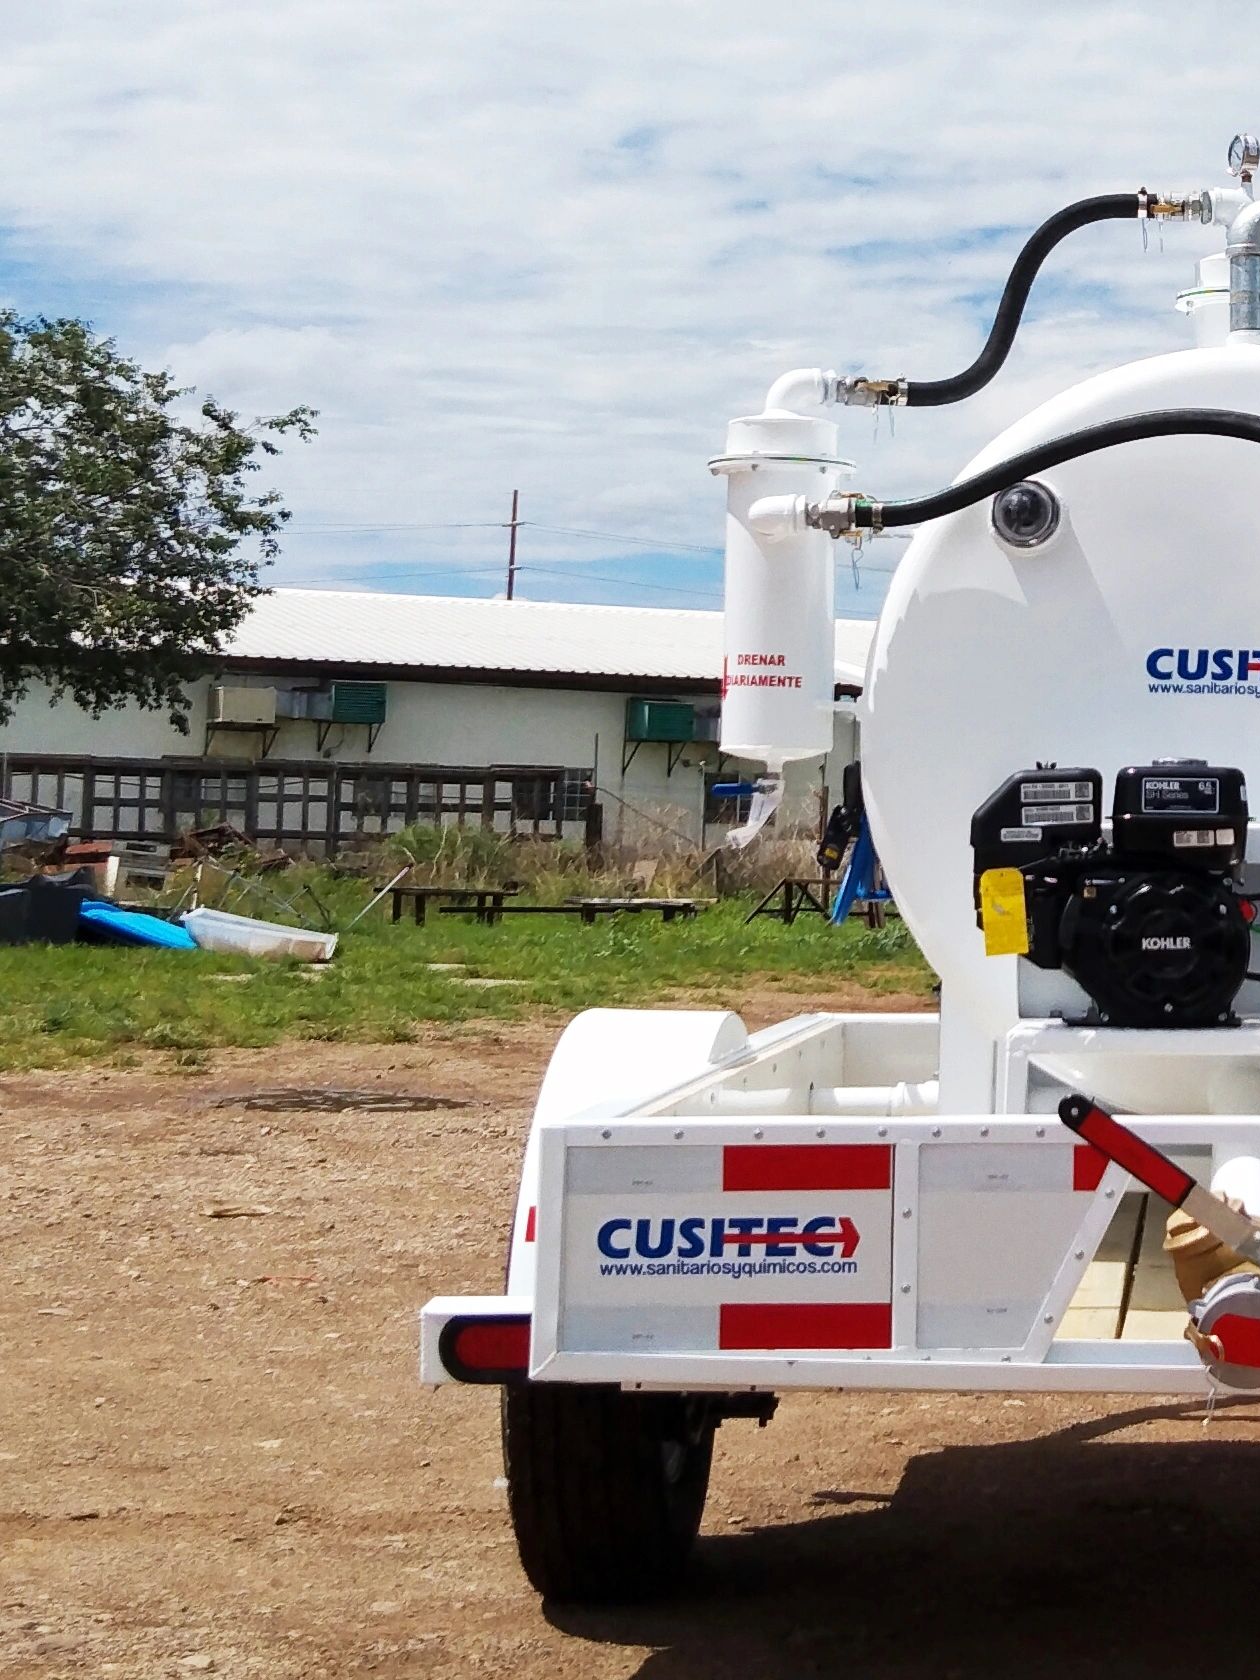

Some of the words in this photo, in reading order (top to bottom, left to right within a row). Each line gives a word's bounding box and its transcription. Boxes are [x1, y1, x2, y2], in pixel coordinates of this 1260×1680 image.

[737, 654, 786, 666] DRENAR
[1145, 781, 1180, 790] KOHLER
[1141, 936, 1191, 950] KOHLER
[597, 1217, 836, 1259] CUSITEC
[600, 1259, 858, 1279] www.sanitariosyquimicos.com
